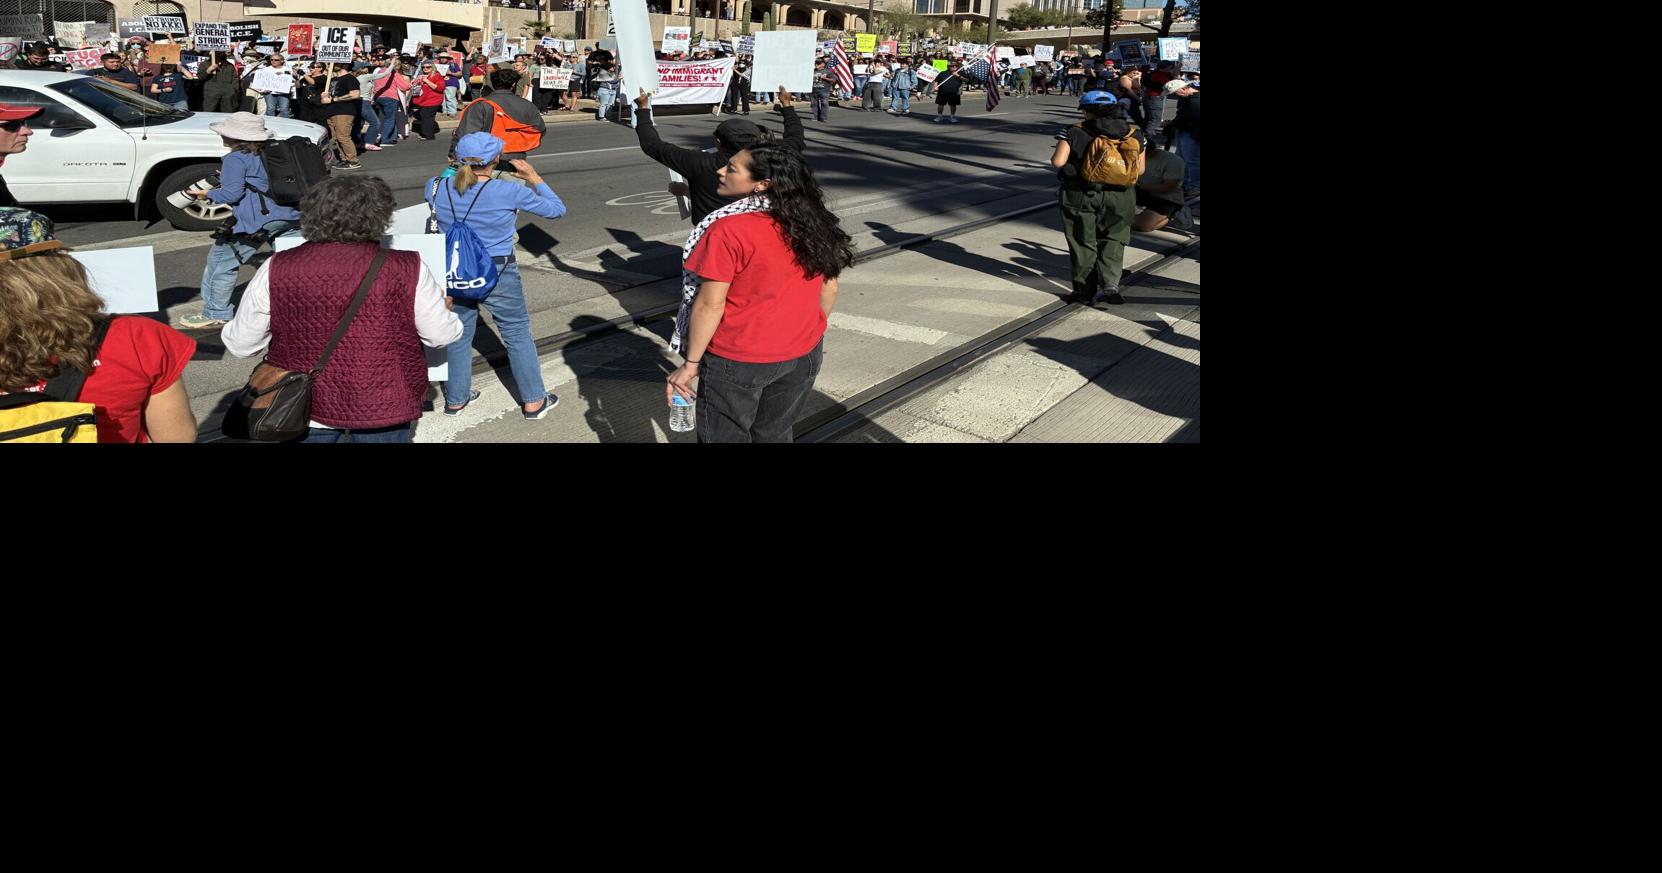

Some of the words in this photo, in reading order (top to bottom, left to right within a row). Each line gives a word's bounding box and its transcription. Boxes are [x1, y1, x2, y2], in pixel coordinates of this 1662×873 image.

[161, 21, 183, 29] KKK!
[327, 28, 348, 43] ICE
[198, 37, 228, 45] STRIKE!
